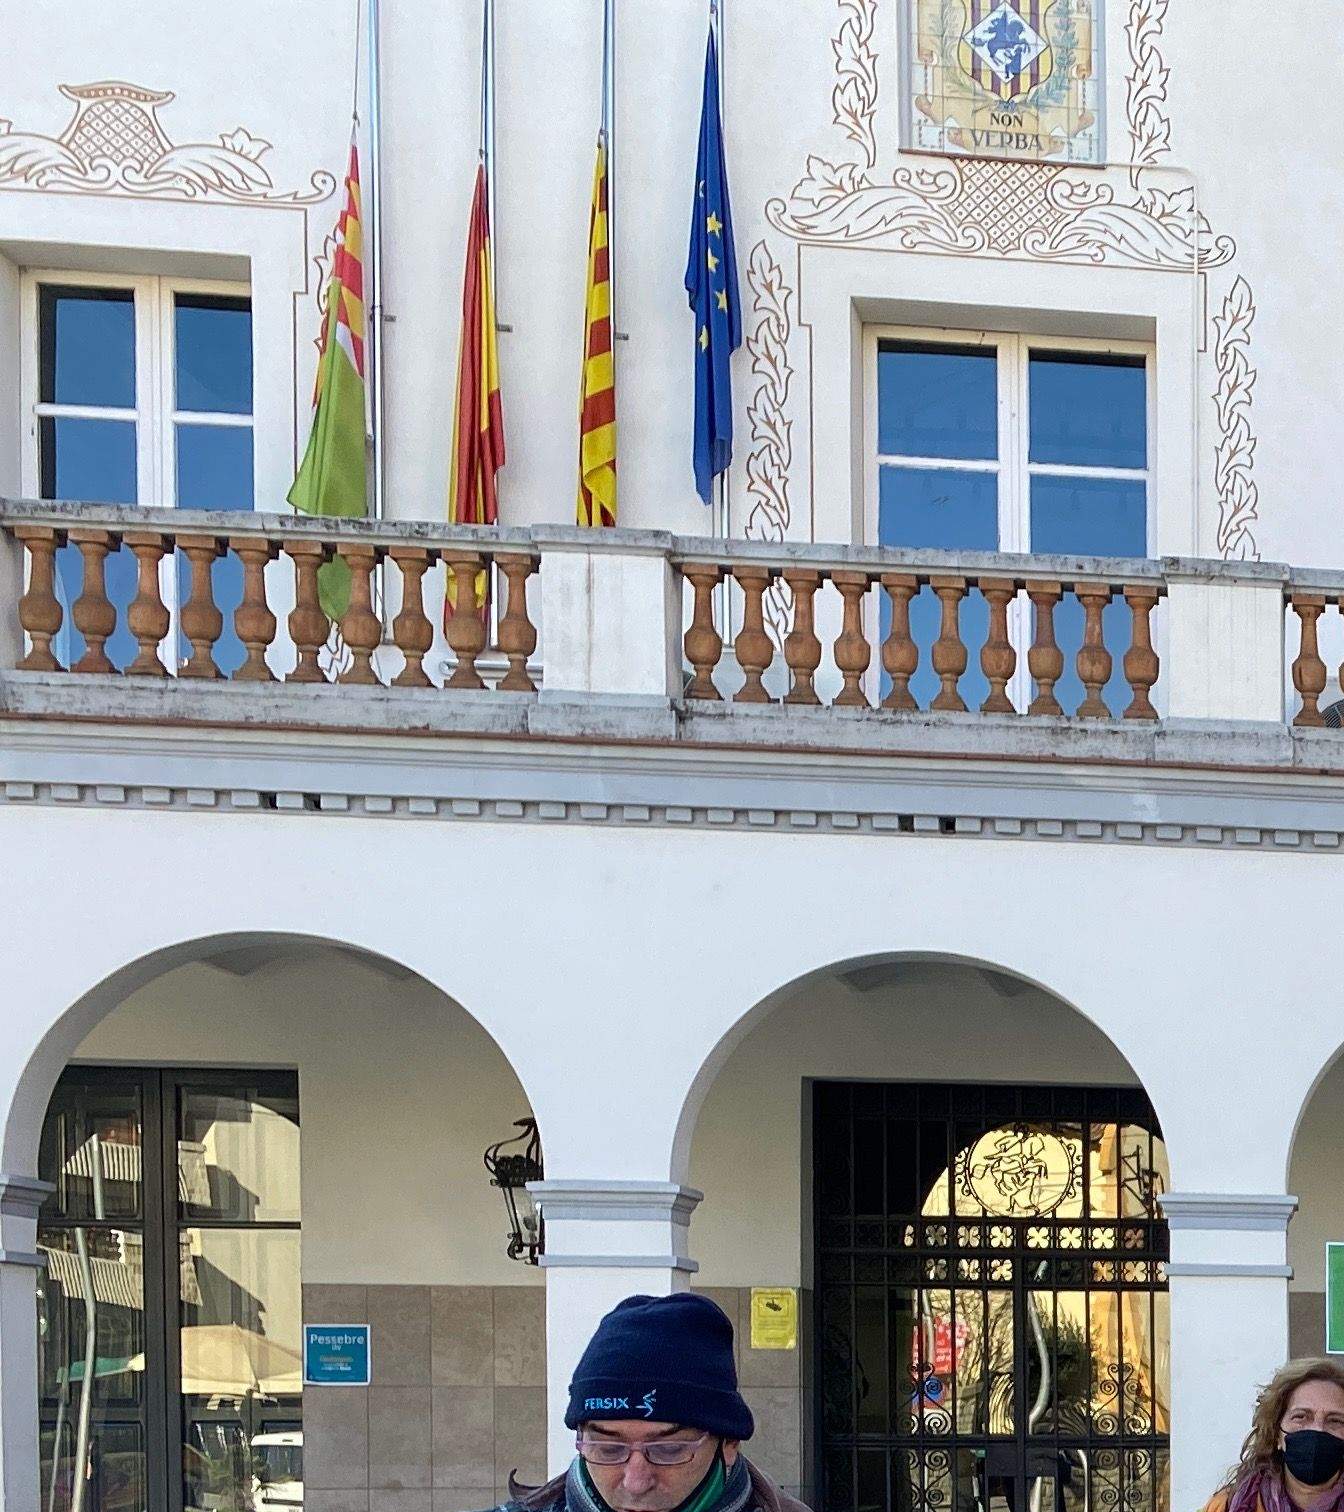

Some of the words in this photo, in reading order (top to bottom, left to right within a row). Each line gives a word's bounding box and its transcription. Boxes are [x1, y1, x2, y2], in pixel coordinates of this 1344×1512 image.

[990, 113, 1023, 127] NON
[970, 129, 1043, 151] VERBA
[310, 1333, 365, 1345] Pessebre
